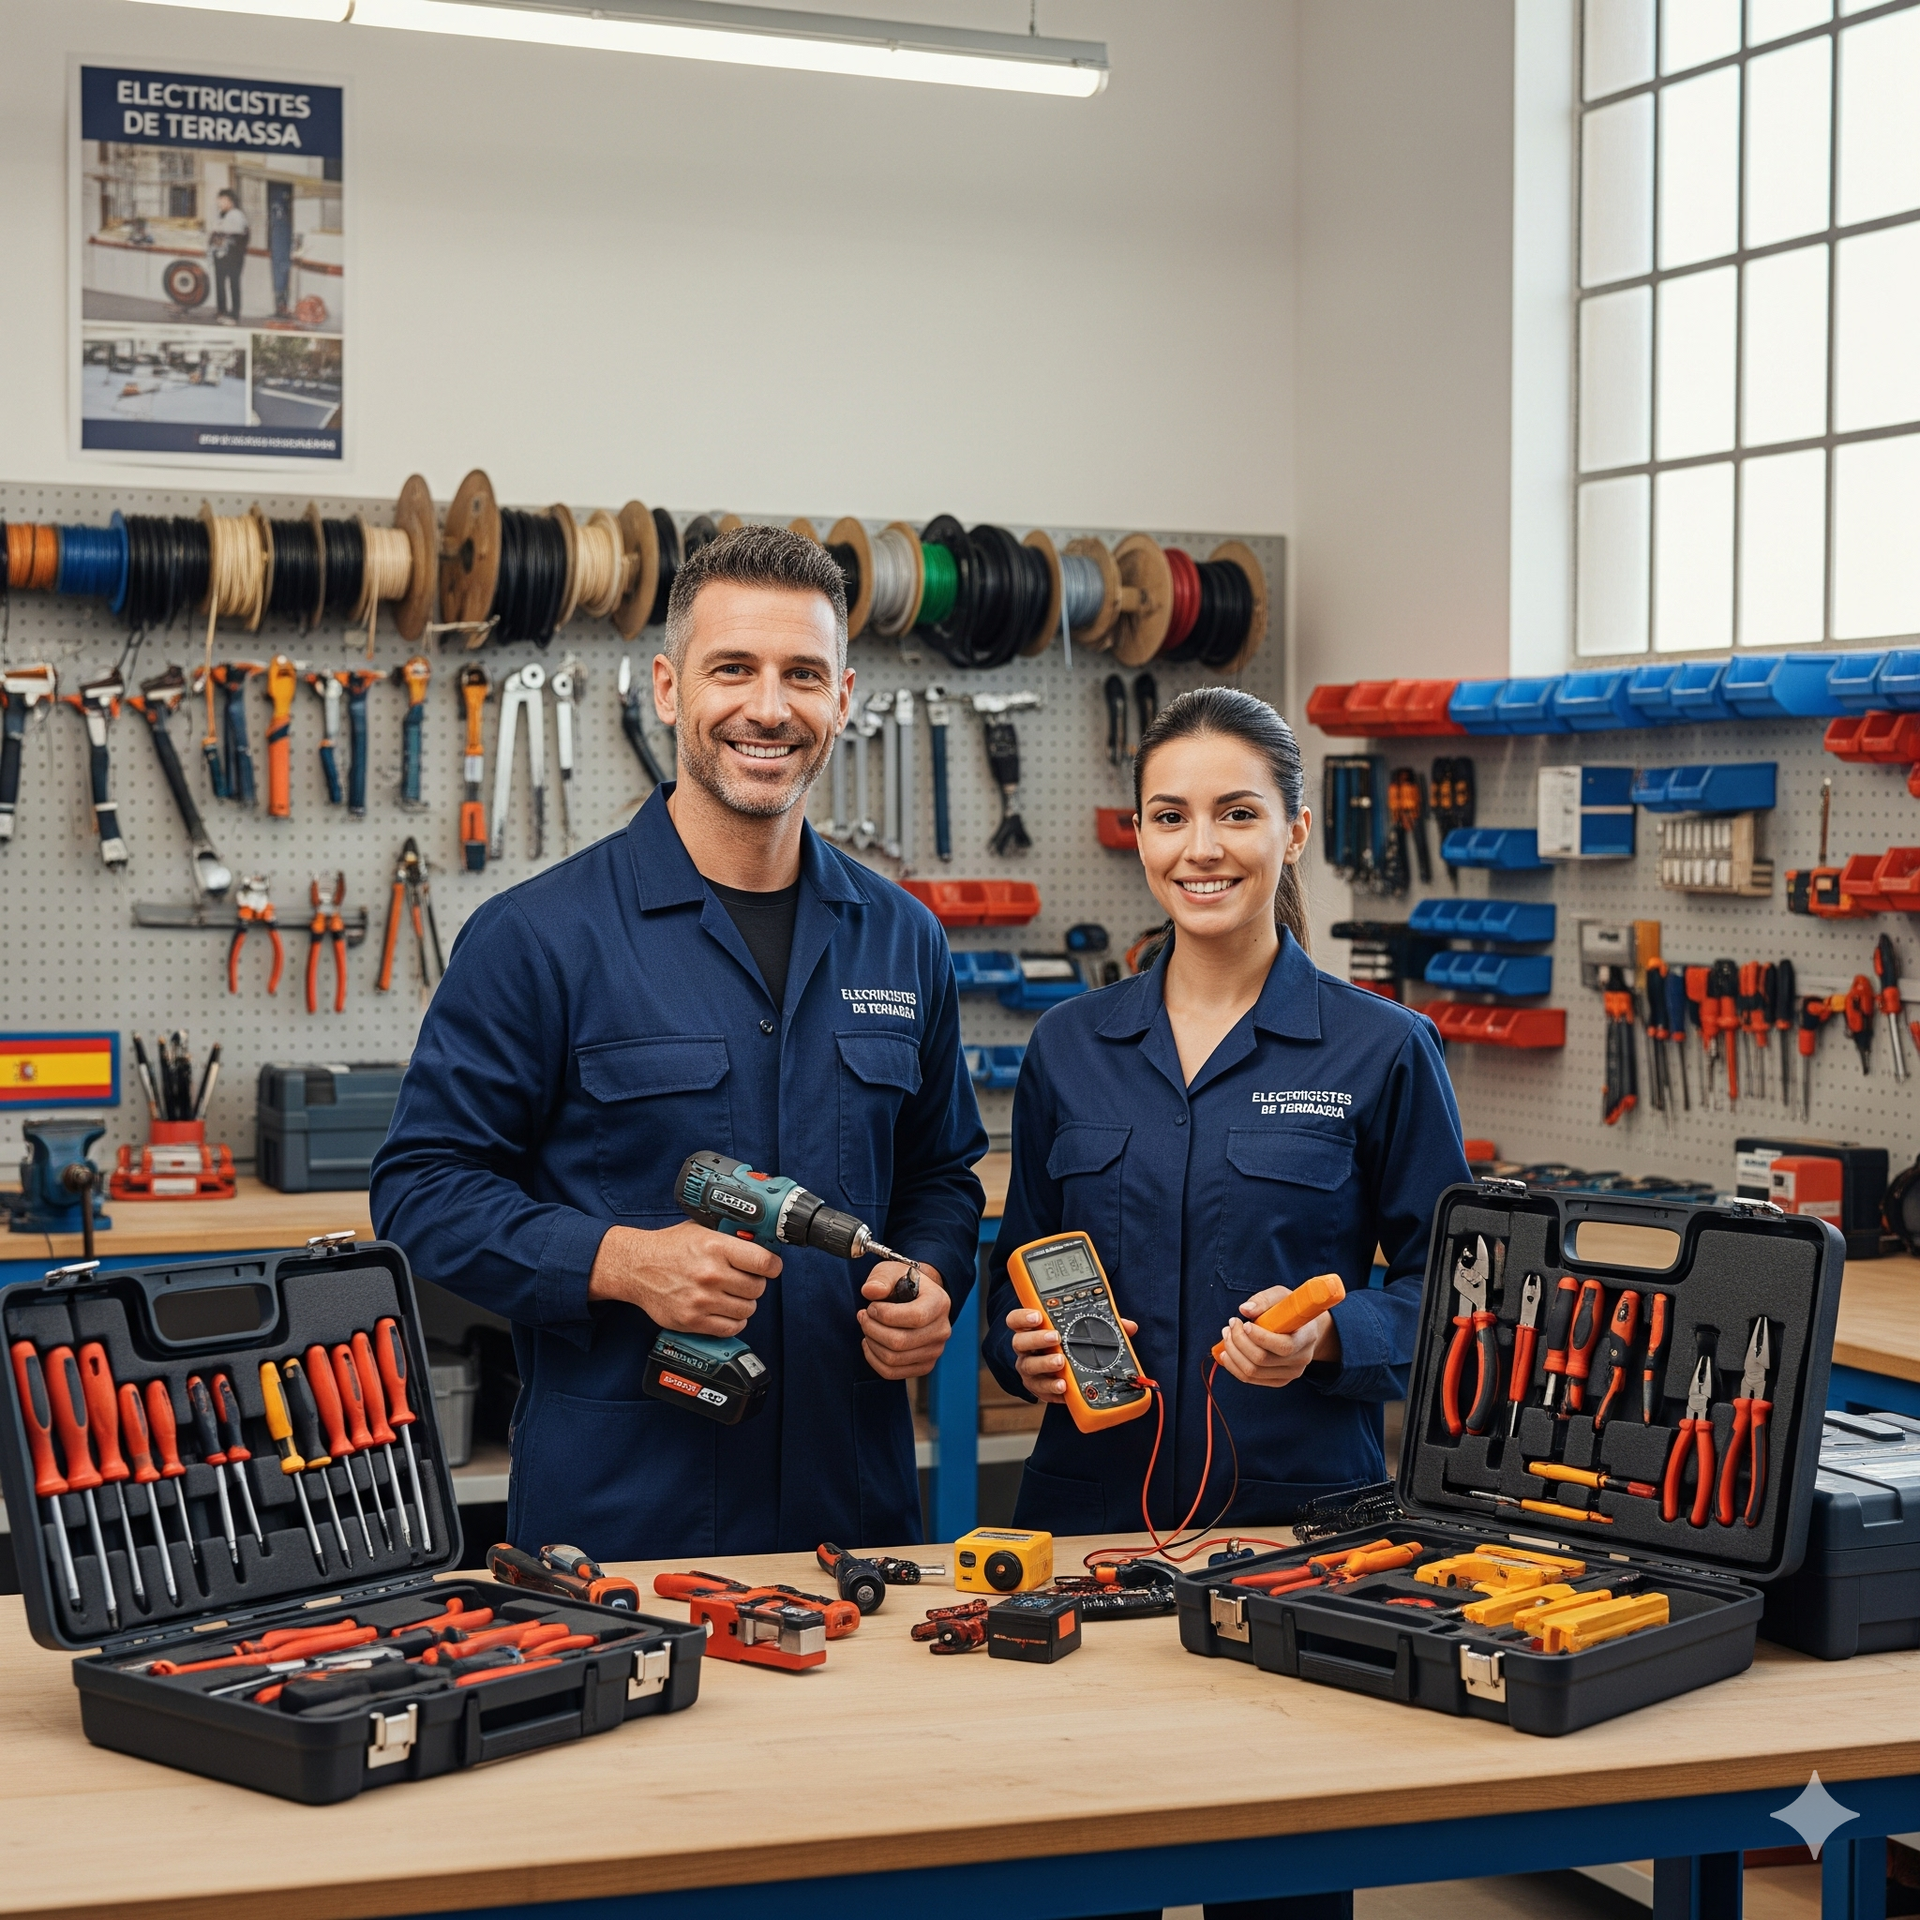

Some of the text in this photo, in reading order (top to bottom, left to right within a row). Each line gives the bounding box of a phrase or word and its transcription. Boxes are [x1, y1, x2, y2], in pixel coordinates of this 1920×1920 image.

[117, 80, 311, 119] ELECTRICISTES
[123, 110, 302, 148] DE TERRASSA
